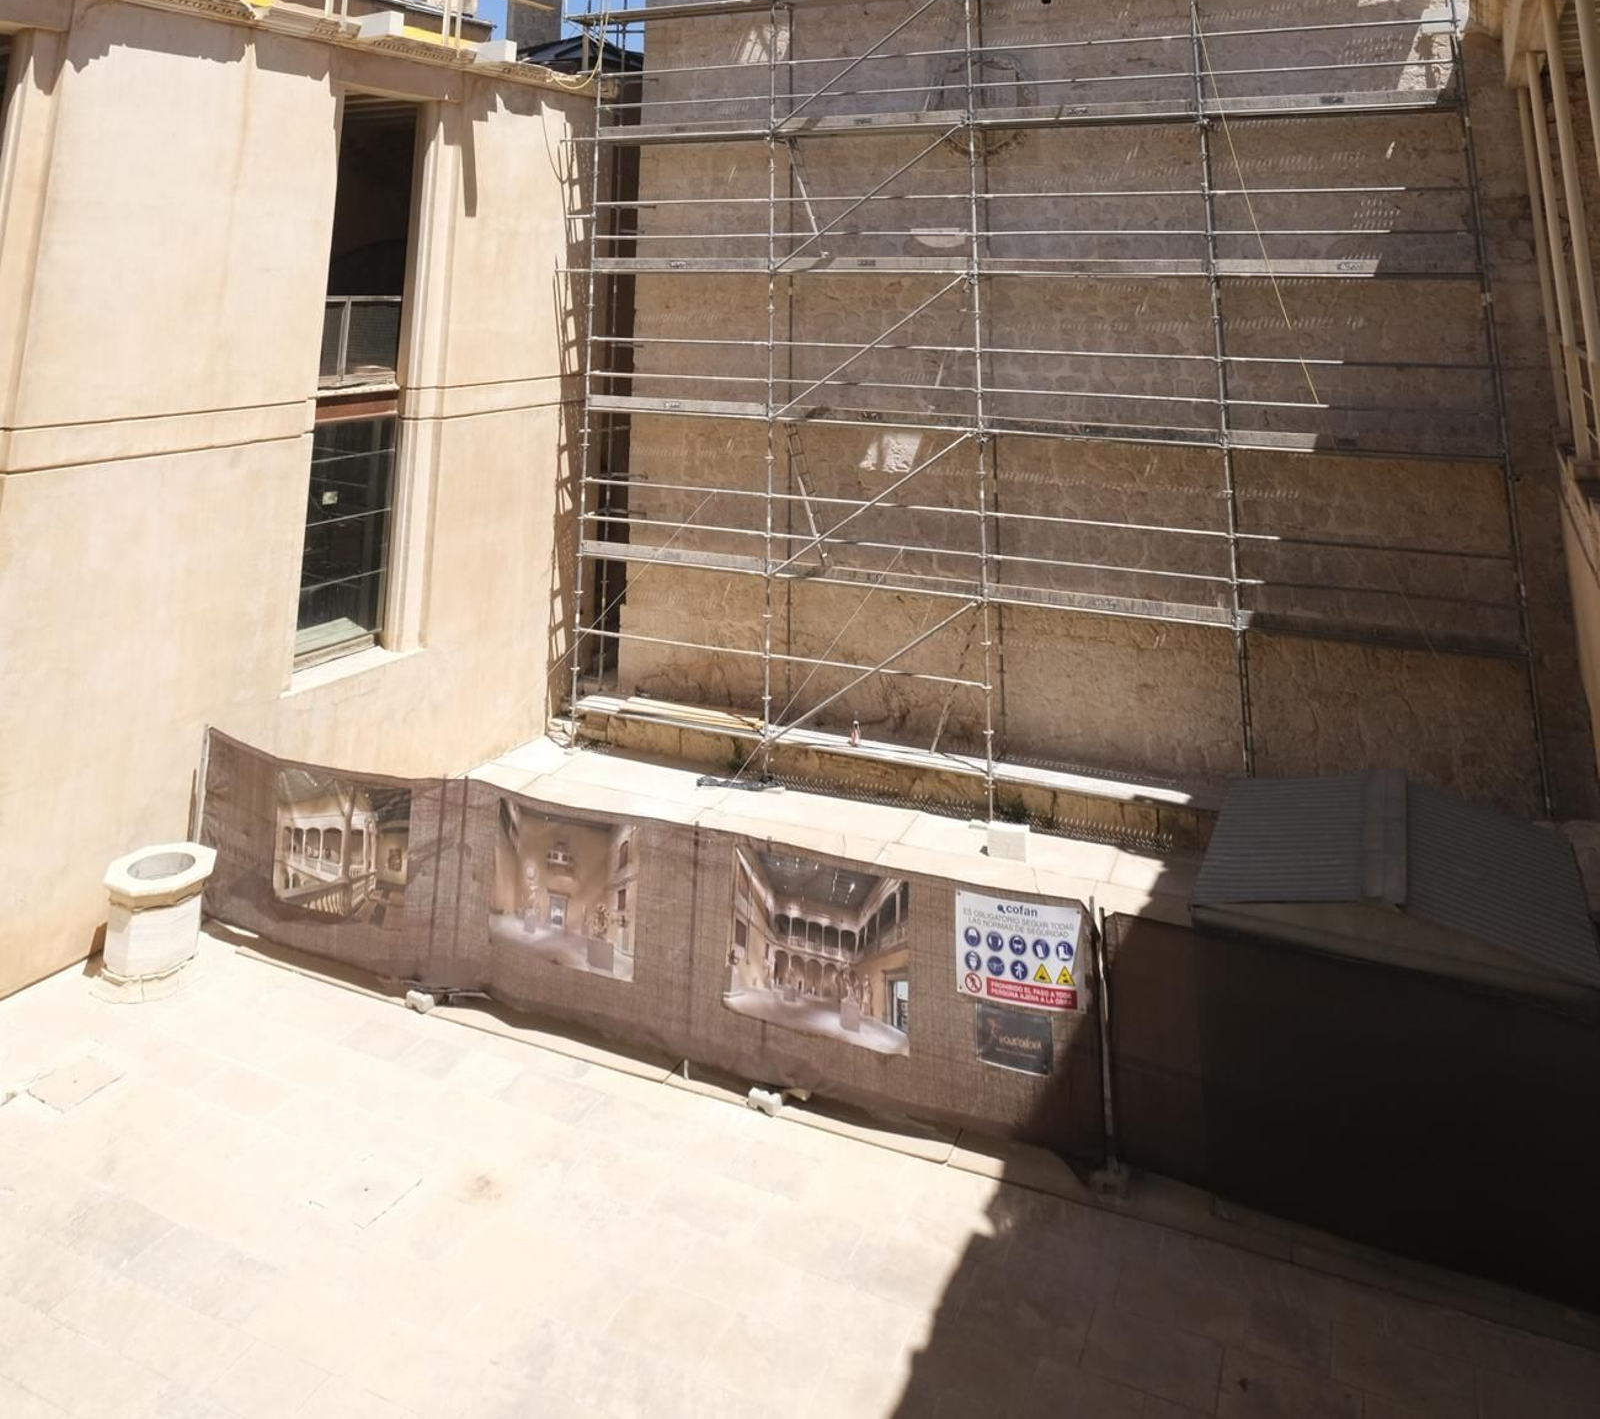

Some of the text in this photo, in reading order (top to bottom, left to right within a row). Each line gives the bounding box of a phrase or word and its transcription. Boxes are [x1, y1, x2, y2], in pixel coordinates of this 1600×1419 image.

[963, 907, 1074, 931] ES OBLIGATORIO SEGUIR TODAS
[1006, 905, 1038, 917] cofan
[968, 917, 1069, 937] LAS NORMAS DE SEGURIDAD
[991, 981, 1023, 993] PROHIBIDO
[1033, 988, 1049, 996] PASO
[1055, 991, 1072, 999] TODA
[991, 988, 1018, 998] PERSONA
[1019, 993, 1039, 1002] AJENA
